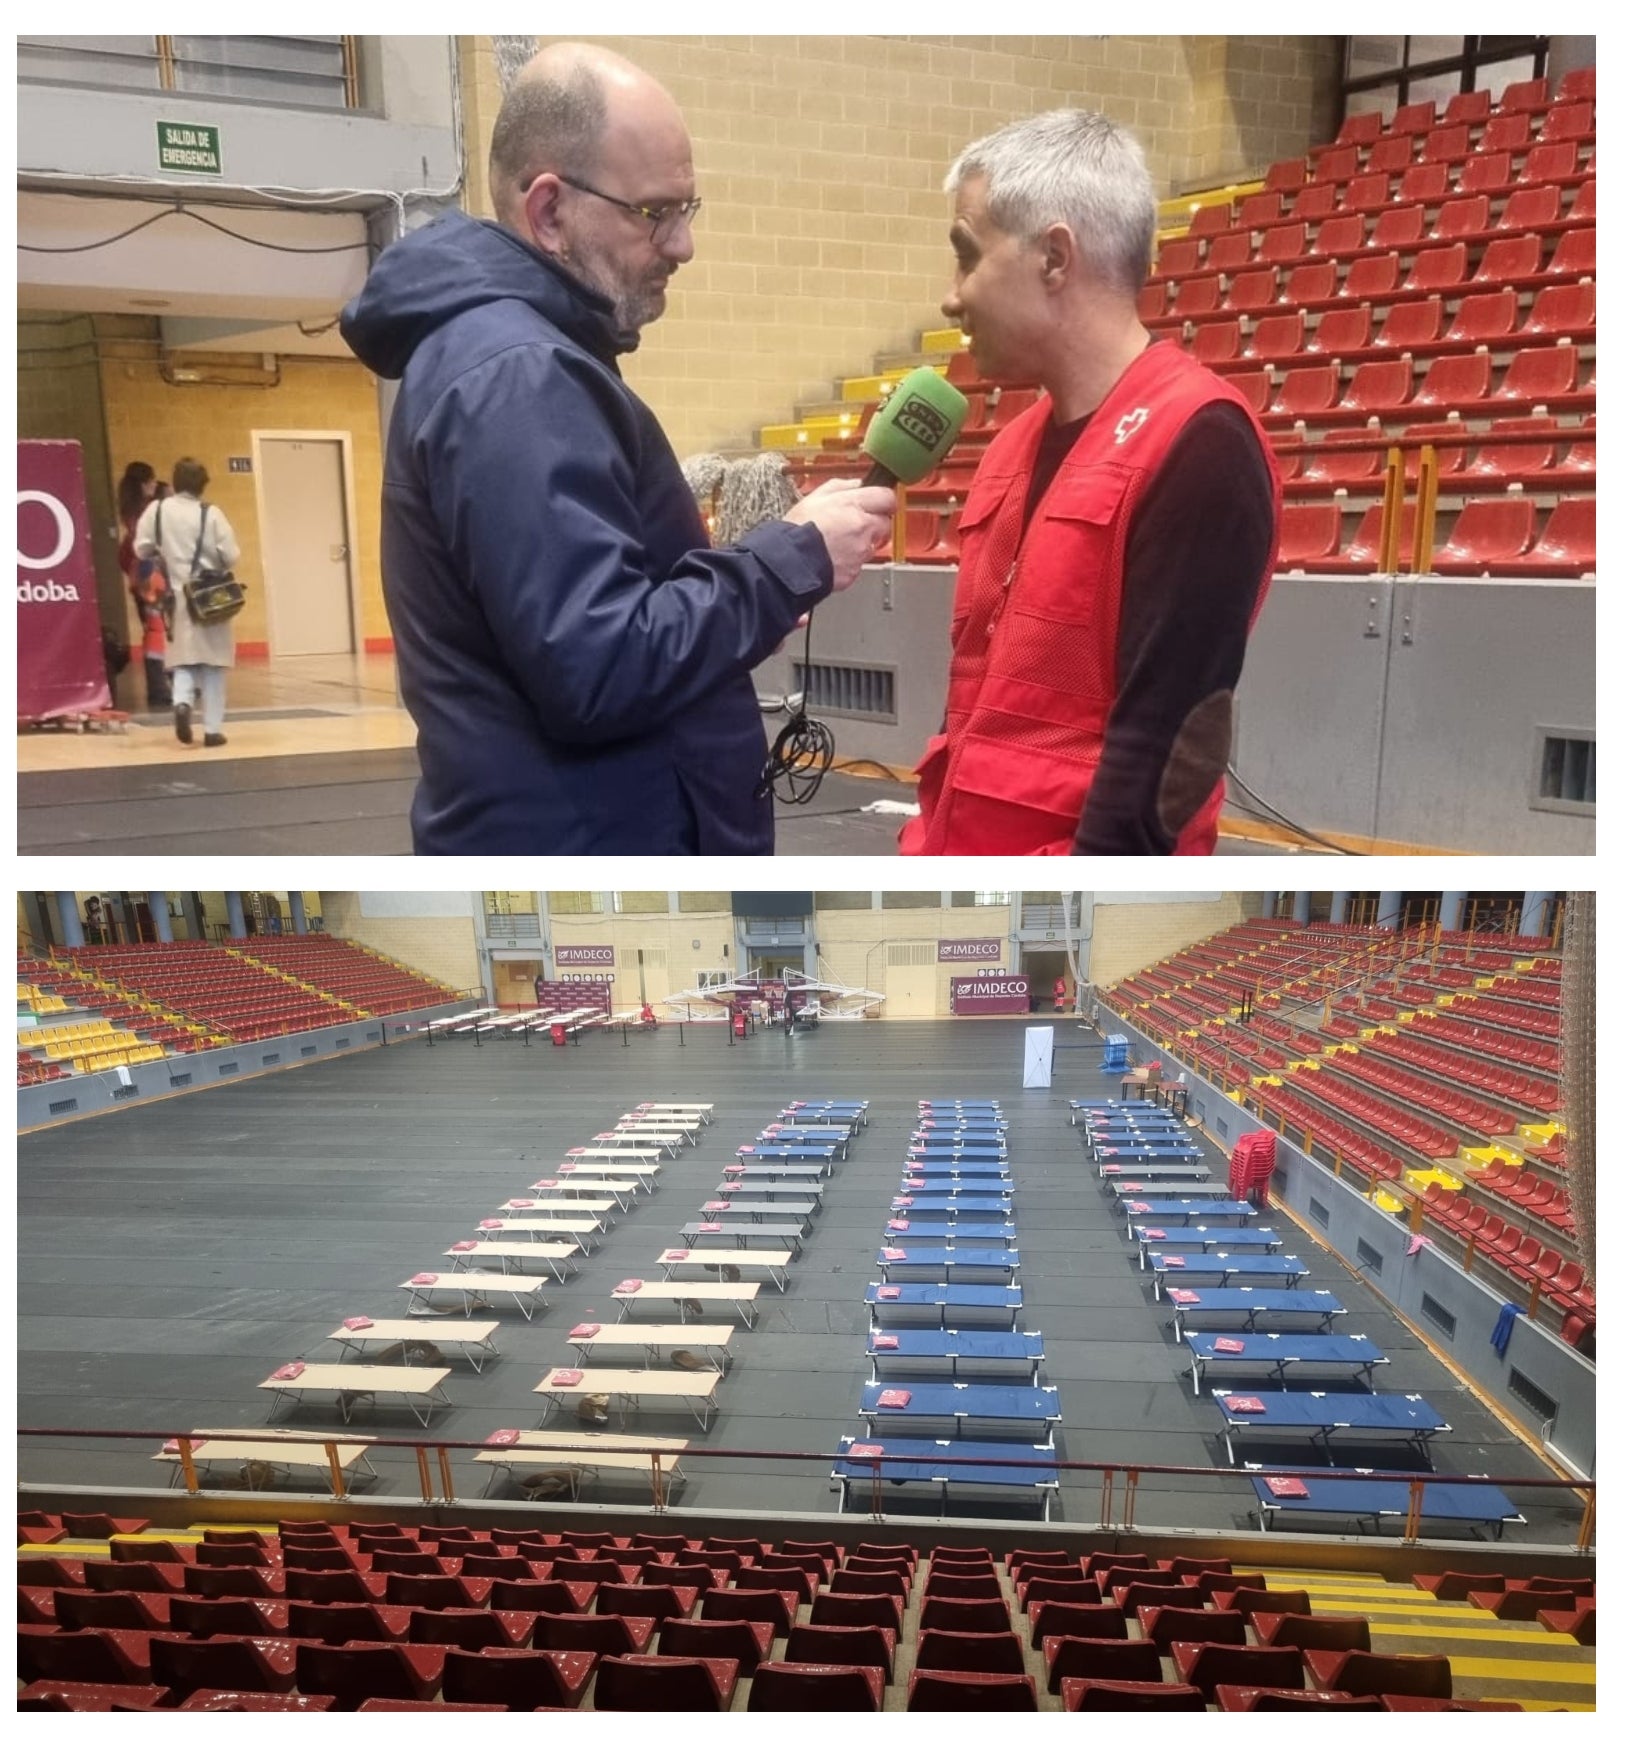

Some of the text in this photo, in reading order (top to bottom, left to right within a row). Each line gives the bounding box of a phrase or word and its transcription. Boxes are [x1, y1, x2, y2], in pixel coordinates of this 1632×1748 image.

[166, 128, 210, 148] SALIDA DE
[162, 147, 218, 168] EMERGENCIA
[569, 949, 612, 960] IMDECO
[953, 944, 999, 956] IMDECO
[973, 981, 1028, 995] IMDECO
